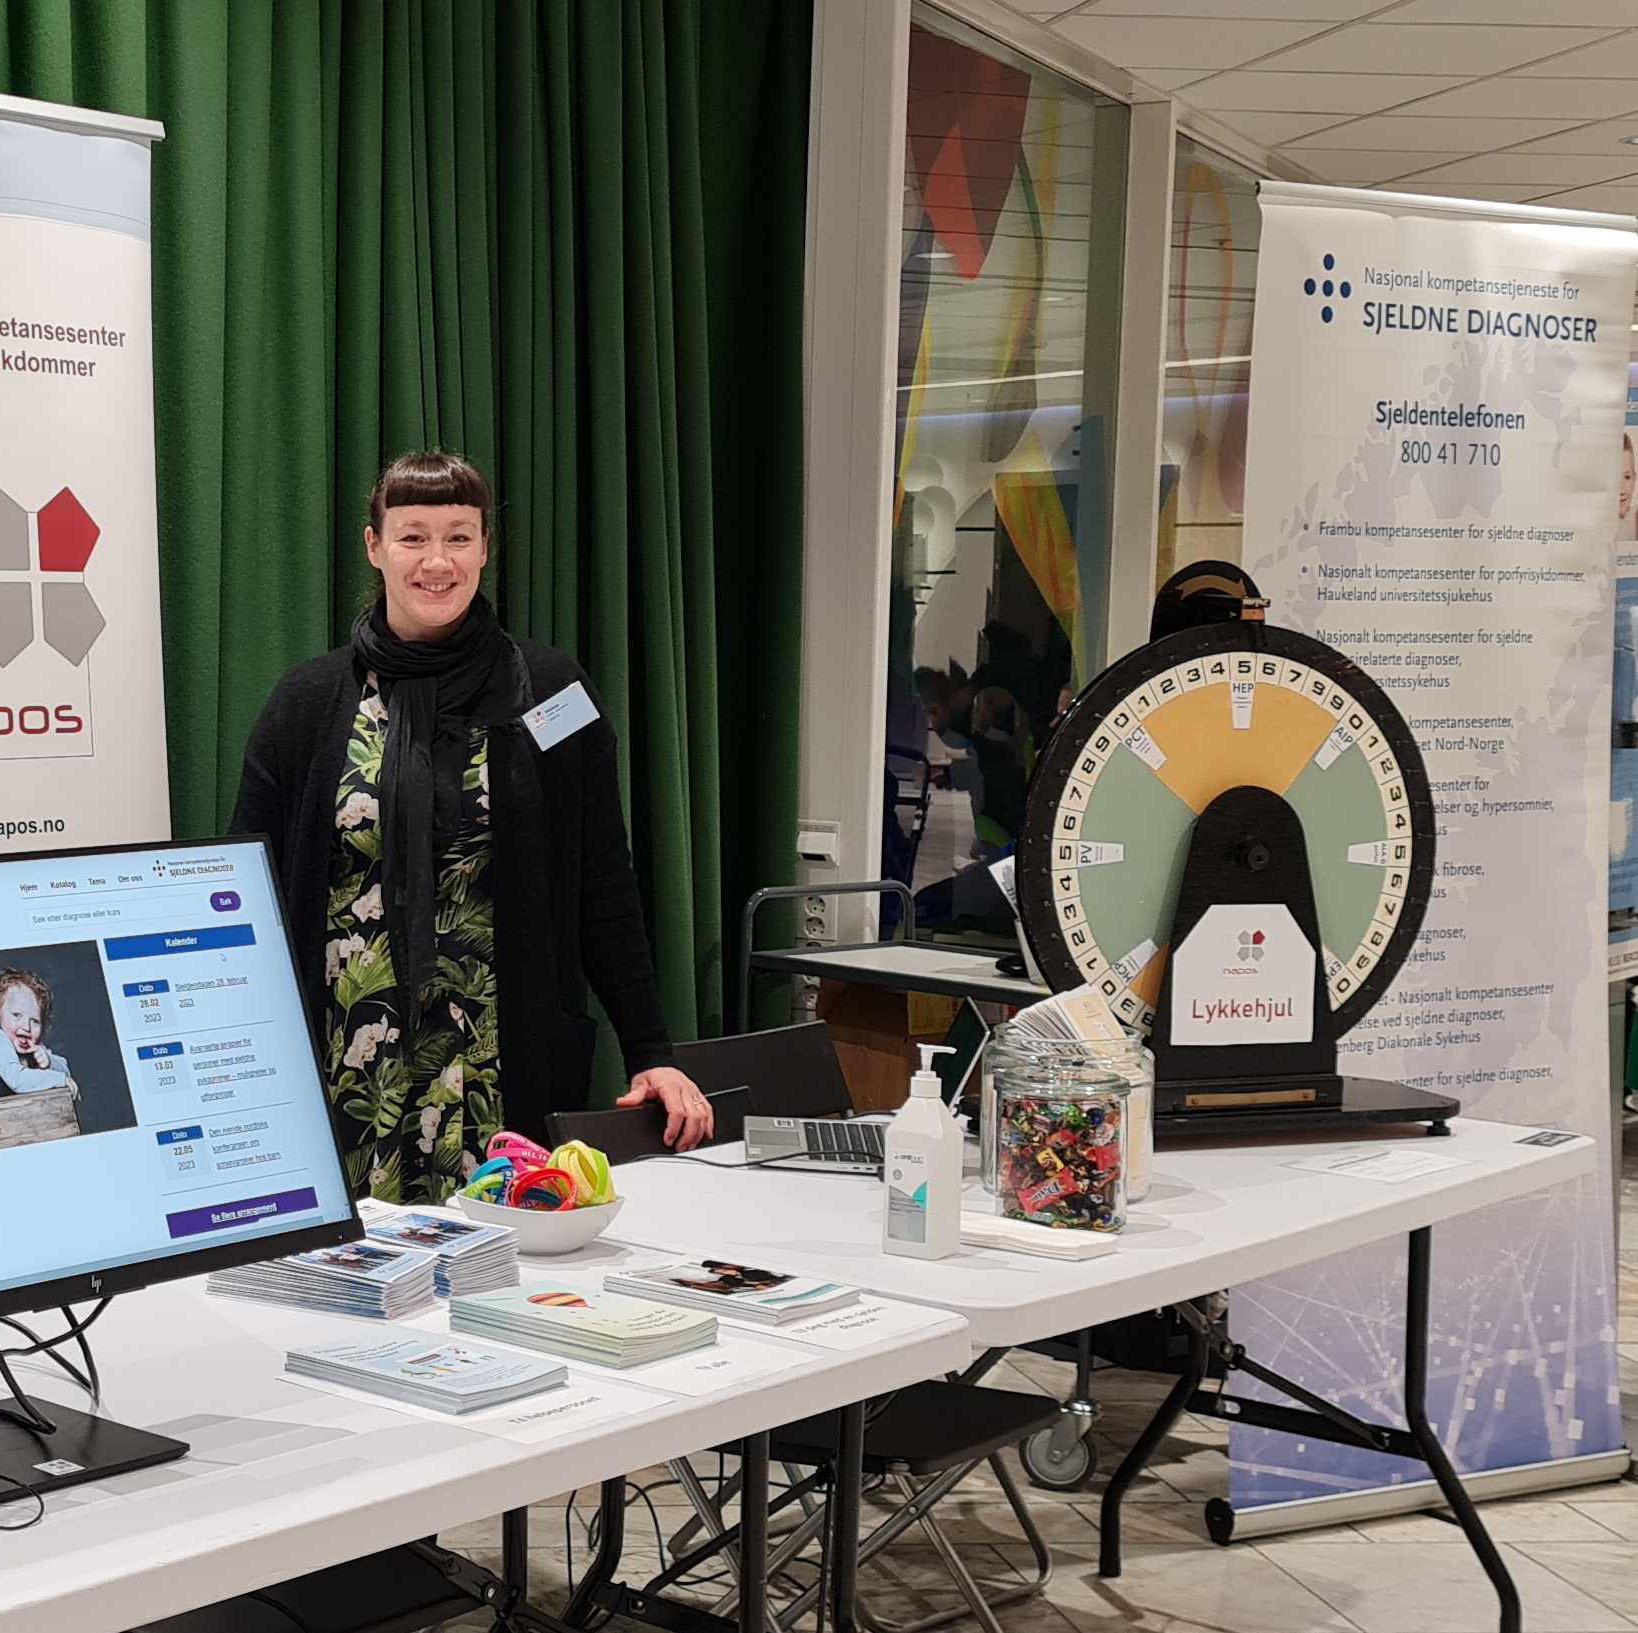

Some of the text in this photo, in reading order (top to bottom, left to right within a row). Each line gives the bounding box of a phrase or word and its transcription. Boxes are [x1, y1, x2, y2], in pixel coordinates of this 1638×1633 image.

[1365, 267, 1580, 300] Nasjonal kompetansetjeneste for
[1363, 302, 1597, 342] SJELDNE DIAGNOSER
[1376, 400, 1524, 430] Sjeldentelefonen
[1401, 441, 1500, 466] 800 41 710
[1320, 521, 1574, 544] Frambu kompetansesenter for sjeldne diagnoser
[1319, 564, 1371, 581] Nasjonalt
[1375, 564, 1475, 583] kompetansesenter
[1479, 565, 1495, 580] for
[1317, 586, 1492, 606] Haukeland universitetssjukehus
[1317, 629, 1533, 647] Nasjonalt kompetansesenter for sjeldne
[1211, 662, 1226, 674] 4
[1238, 660, 1252, 674] 5
[1406, 651, 1461, 670] diagnoser,
[1186, 668, 1201, 682] 3
[1262, 662, 1276, 676] 6
[1290, 670, 1302, 682] 7
[1160, 678, 1176, 694] 2
[1232, 683, 1254, 693] HEP
[1138, 696, 1150, 708] 1
[1114, 712, 1129, 728] 0
[1348, 714, 1364, 730] 0
[1408, 715, 1513, 732] kompetansesenter,
[1124, 726, 1146, 748] PCT
[1334, 726, 1354, 744] AIP
[1368, 736, 1378, 748] 1
[1095, 736, 1110, 752] 9
[1436, 736, 1504, 754] Nord-Norge
[1082, 758, 1096, 774] 8
[1380, 758, 1394, 774] 2
[1474, 776, 1490, 790] for
[1069, 786, 1082, 800] 7
[1390, 786, 1402, 802] 3
[1465, 802, 1479, 817] og
[1482, 798, 1554, 816] hypersomnier,
[1064, 815, 1076, 830] 6
[1395, 814, 1406, 830] 4
[1060, 845, 1072, 861] 5
[1080, 844, 1092, 864] PV
[1394, 844, 1406, 860] 5
[1443, 862, 1484, 876] fibrose,
[50, 880, 76, 890] Katalog
[1060, 875, 1072, 891] 4
[1064, 904, 1077, 920] 3
[1384, 902, 1396, 917] 7
[1407, 948, 1446, 966] ykehus
[1114, 962, 1134, 982] HCP
[1336, 977, 1351, 994] 0
[1399, 987, 1452, 1005] Nasjonalt
[1456, 984, 1554, 1003] kompetansesenter
[144, 1013, 162, 1024] 2023
[1193, 998, 1292, 1024] Lykkehjul
[1383, 1013, 1401, 1027] ved
[1405, 1010, 1444, 1029] sjeldne
[1448, 1009, 1505, 1026] diagnoser,
[1378, 1030, 1481, 1049] Diakonale Sykehus
[1438, 1071, 1453, 1085] for
[1456, 1069, 1496, 1088] sjeldne
[1499, 1067, 1551, 1083] diagnoser,
[177, 1160, 196, 1171] 2023
